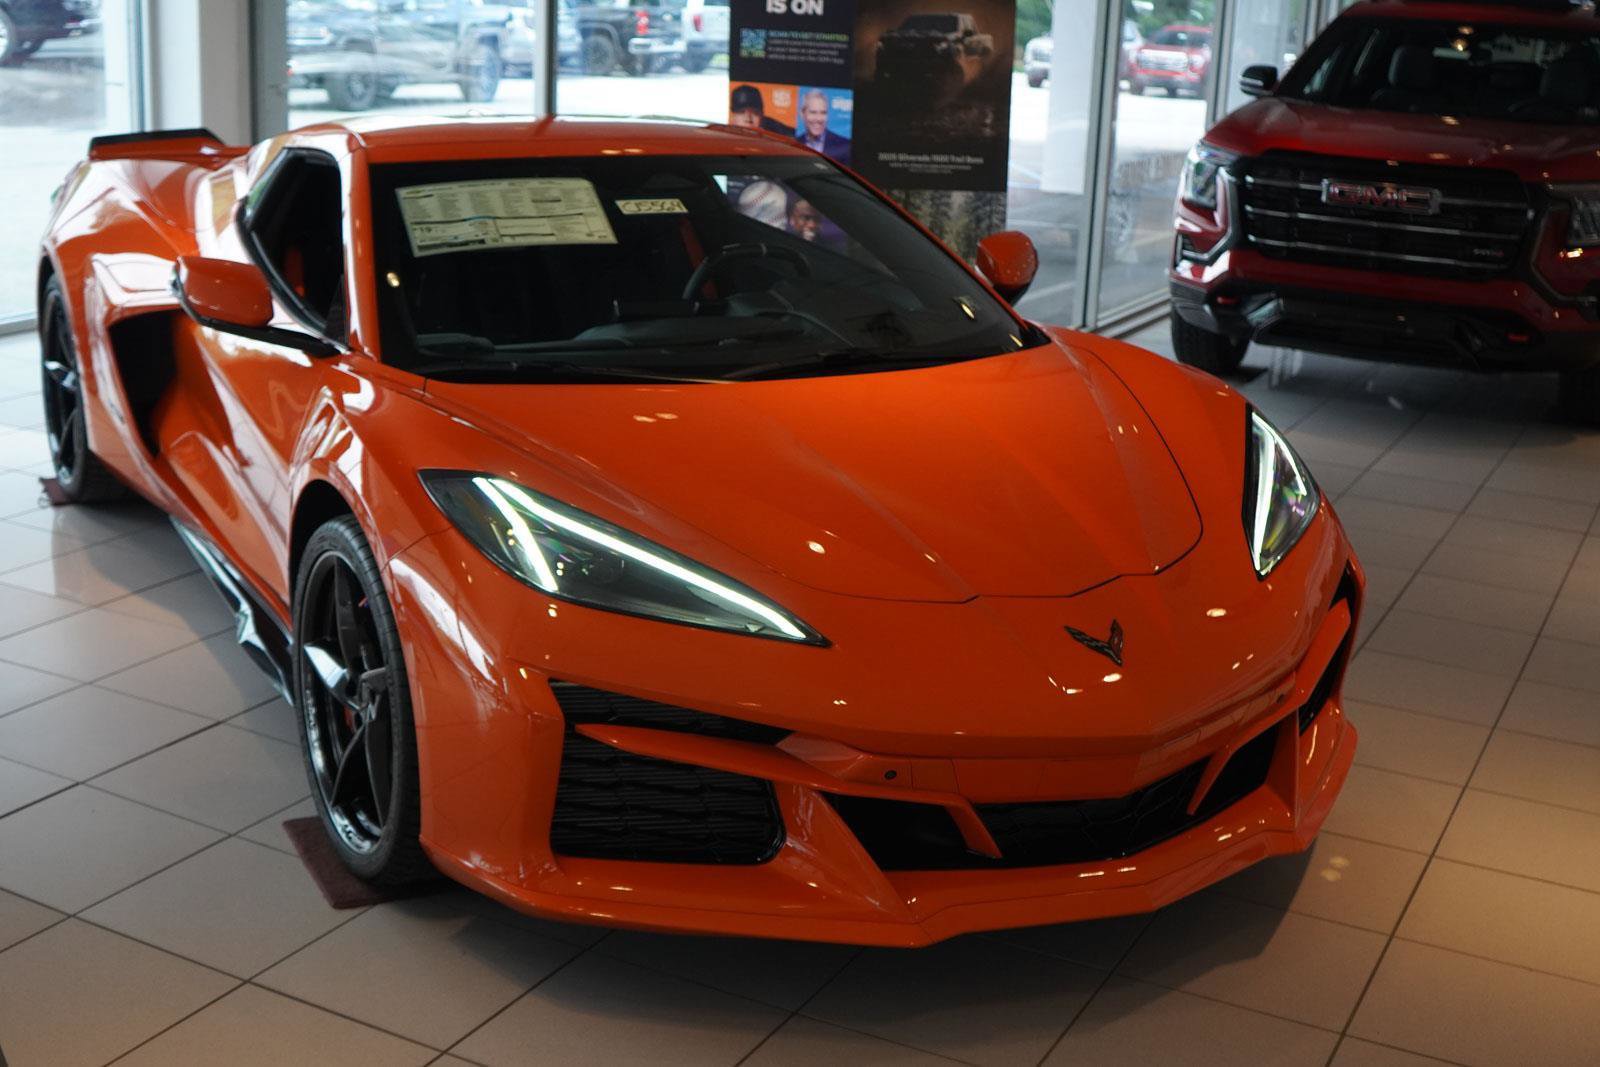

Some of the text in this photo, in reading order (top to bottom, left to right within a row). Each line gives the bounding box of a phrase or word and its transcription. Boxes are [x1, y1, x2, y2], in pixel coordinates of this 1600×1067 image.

[766, 0, 824, 15] IS ON
[1328, 181, 1432, 209] GMC
